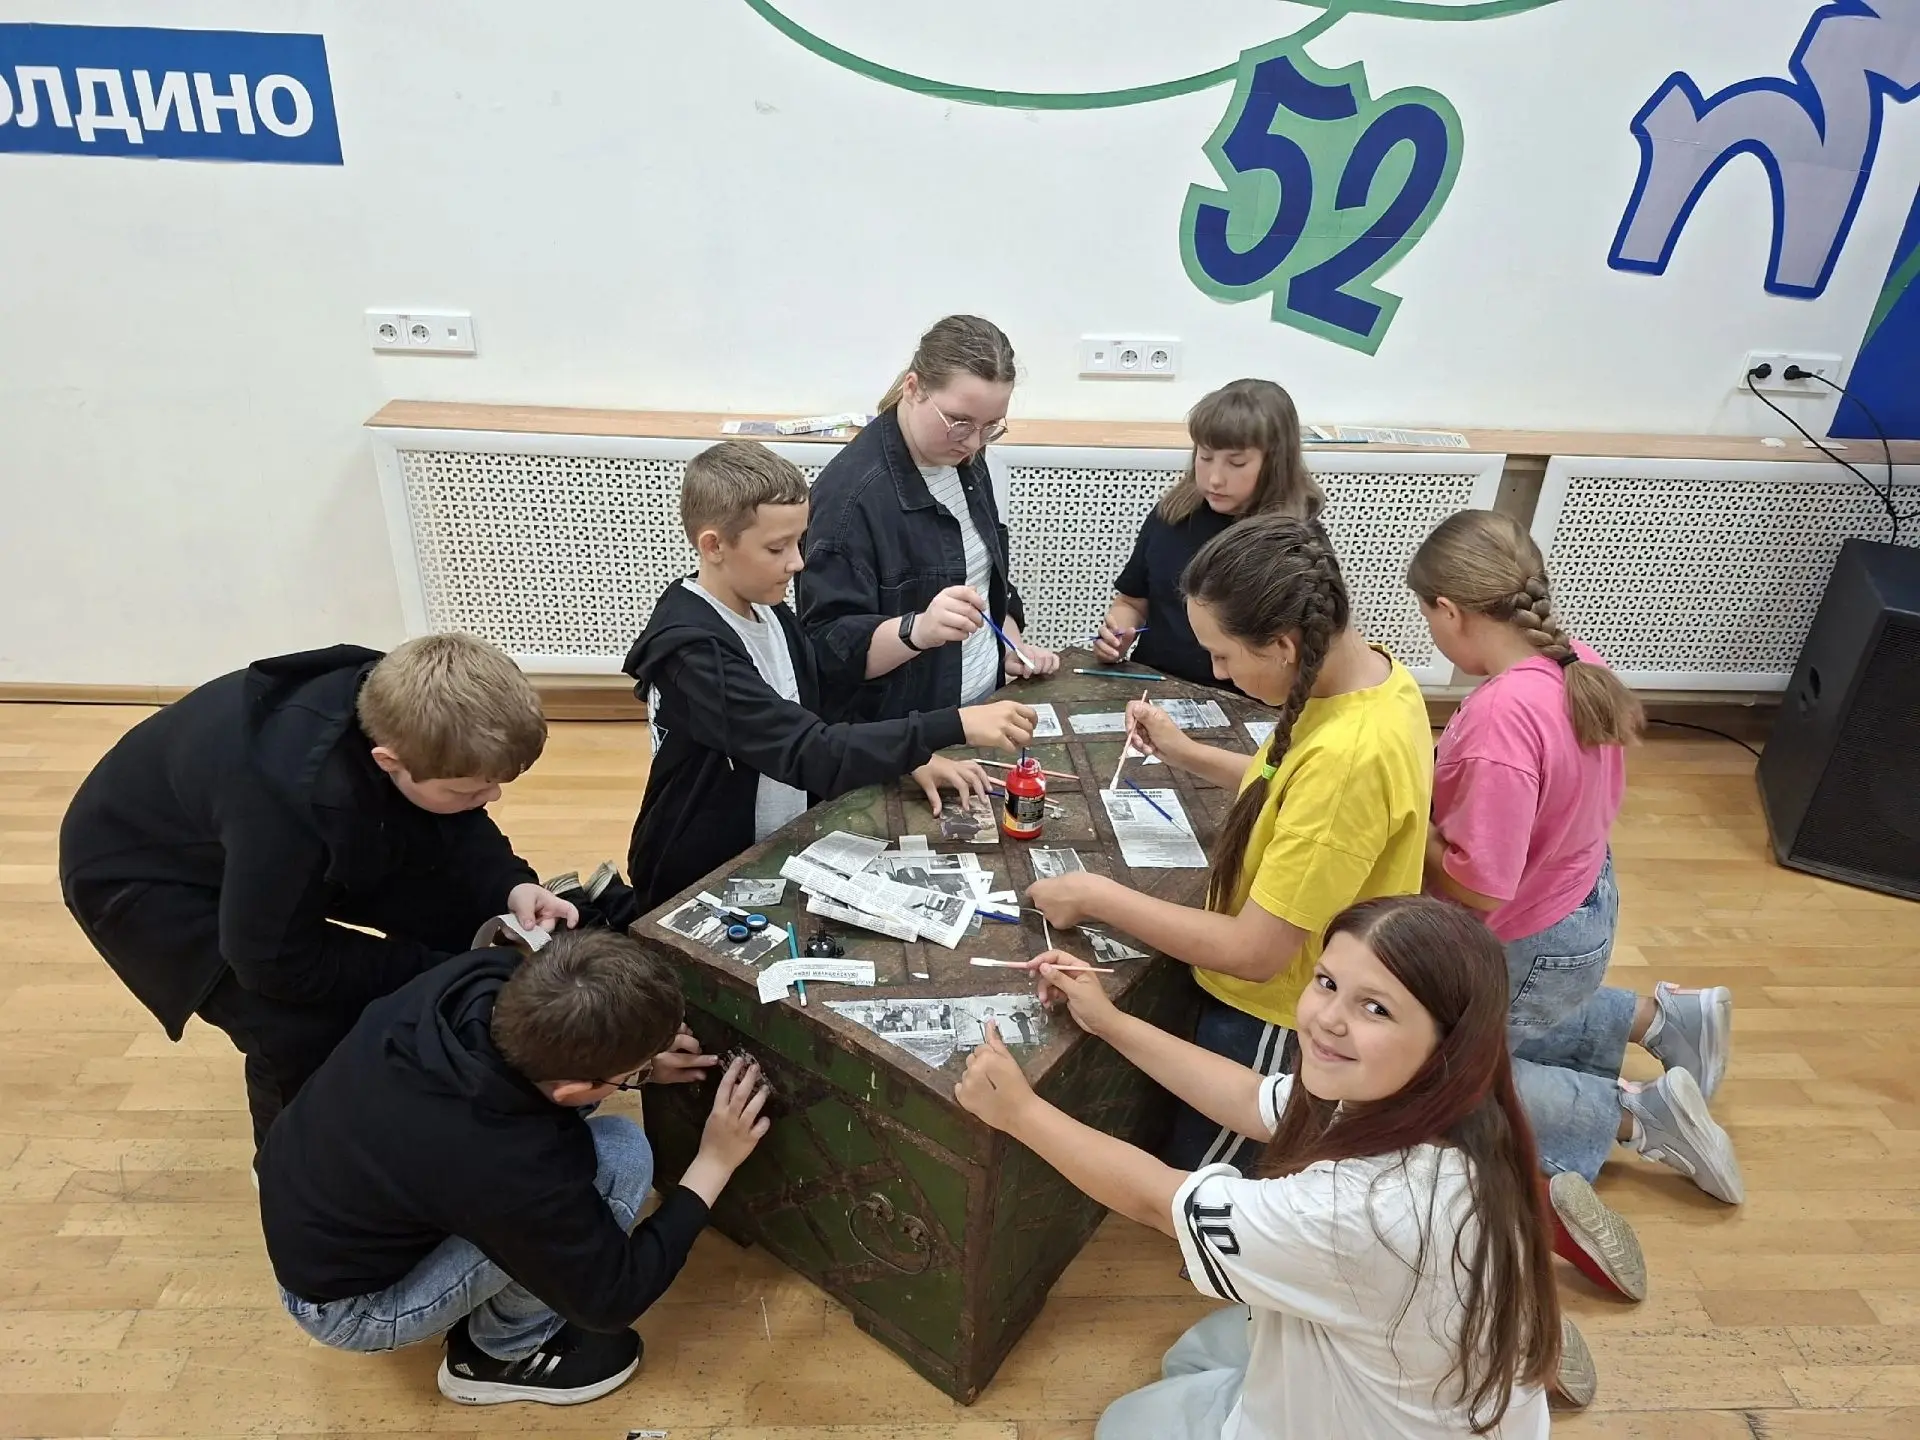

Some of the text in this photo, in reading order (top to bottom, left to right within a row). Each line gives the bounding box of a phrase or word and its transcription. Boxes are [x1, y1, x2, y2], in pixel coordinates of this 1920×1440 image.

[0, 65, 314, 144] ЛДИНО
[1194, 55, 1449, 338] 52
[1193, 1201, 1241, 1257] 10
